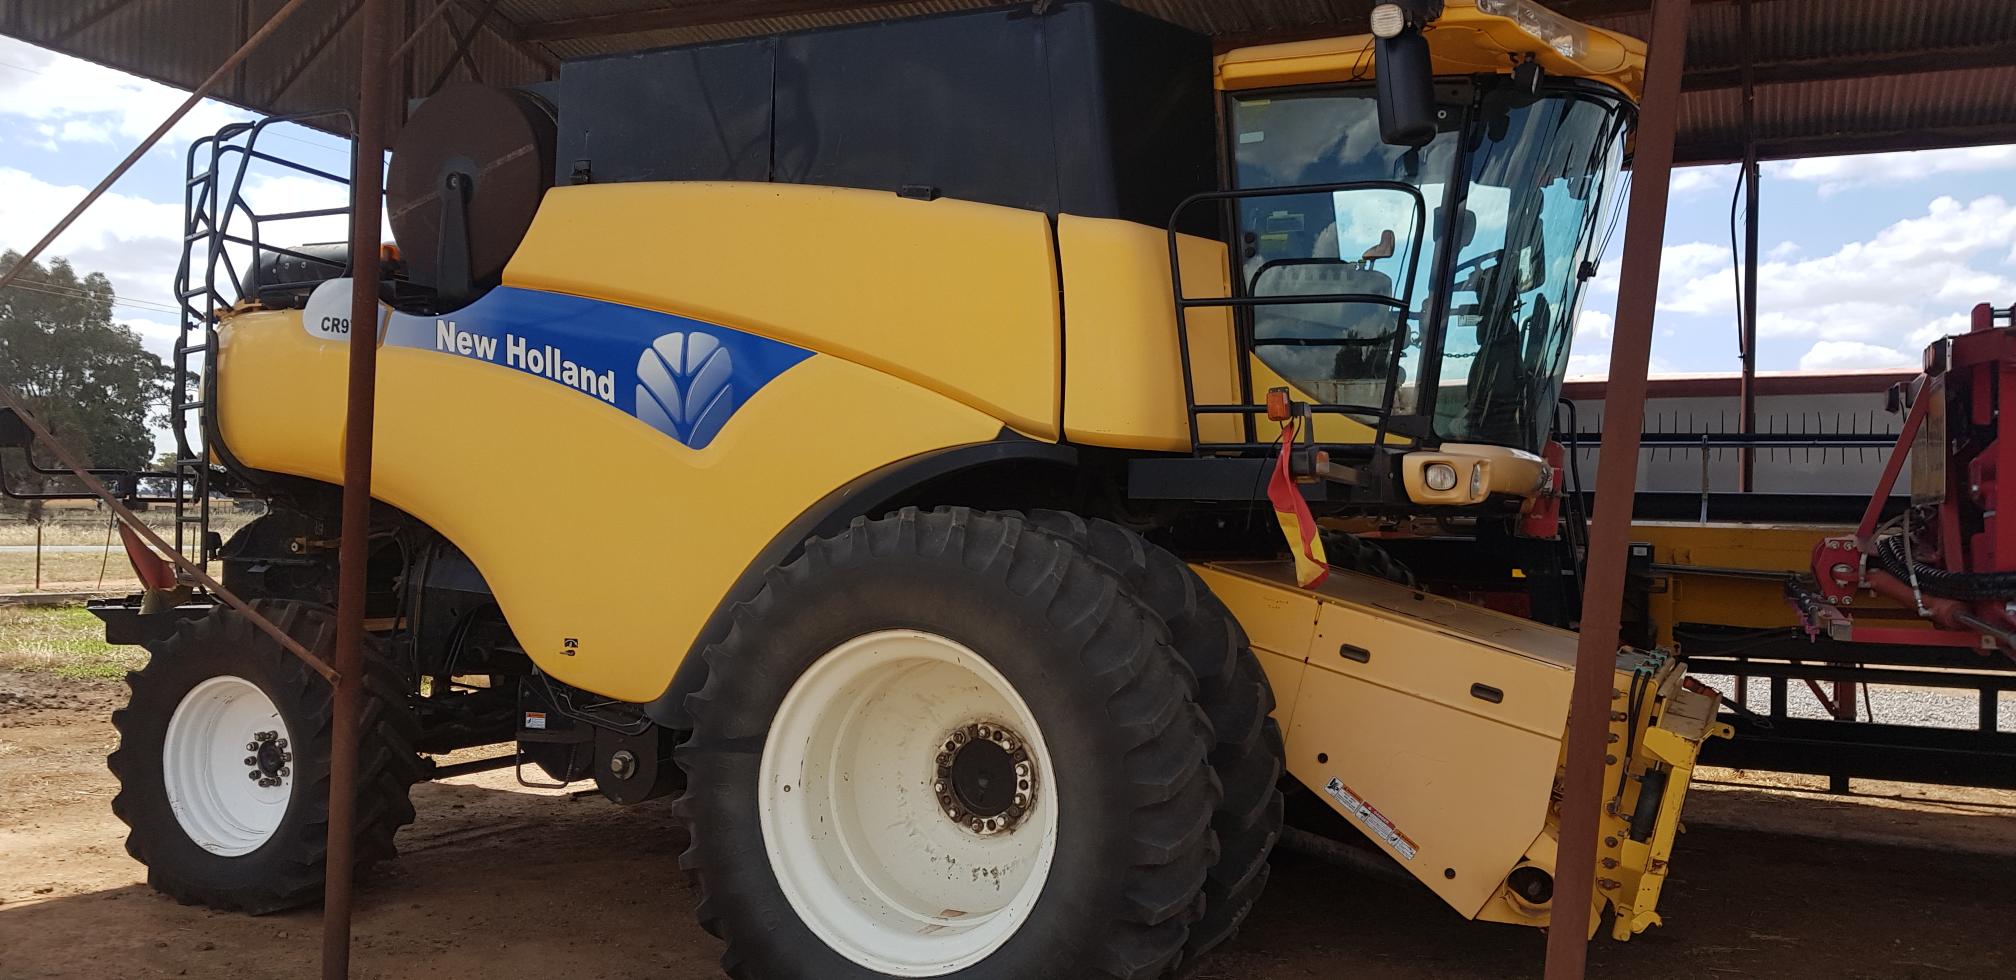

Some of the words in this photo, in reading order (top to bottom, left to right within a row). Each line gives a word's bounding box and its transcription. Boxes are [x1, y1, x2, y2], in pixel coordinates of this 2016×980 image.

[320, 316, 353, 334] CR9
[436, 319, 498, 361] New
[506, 333, 615, 404] Holland
